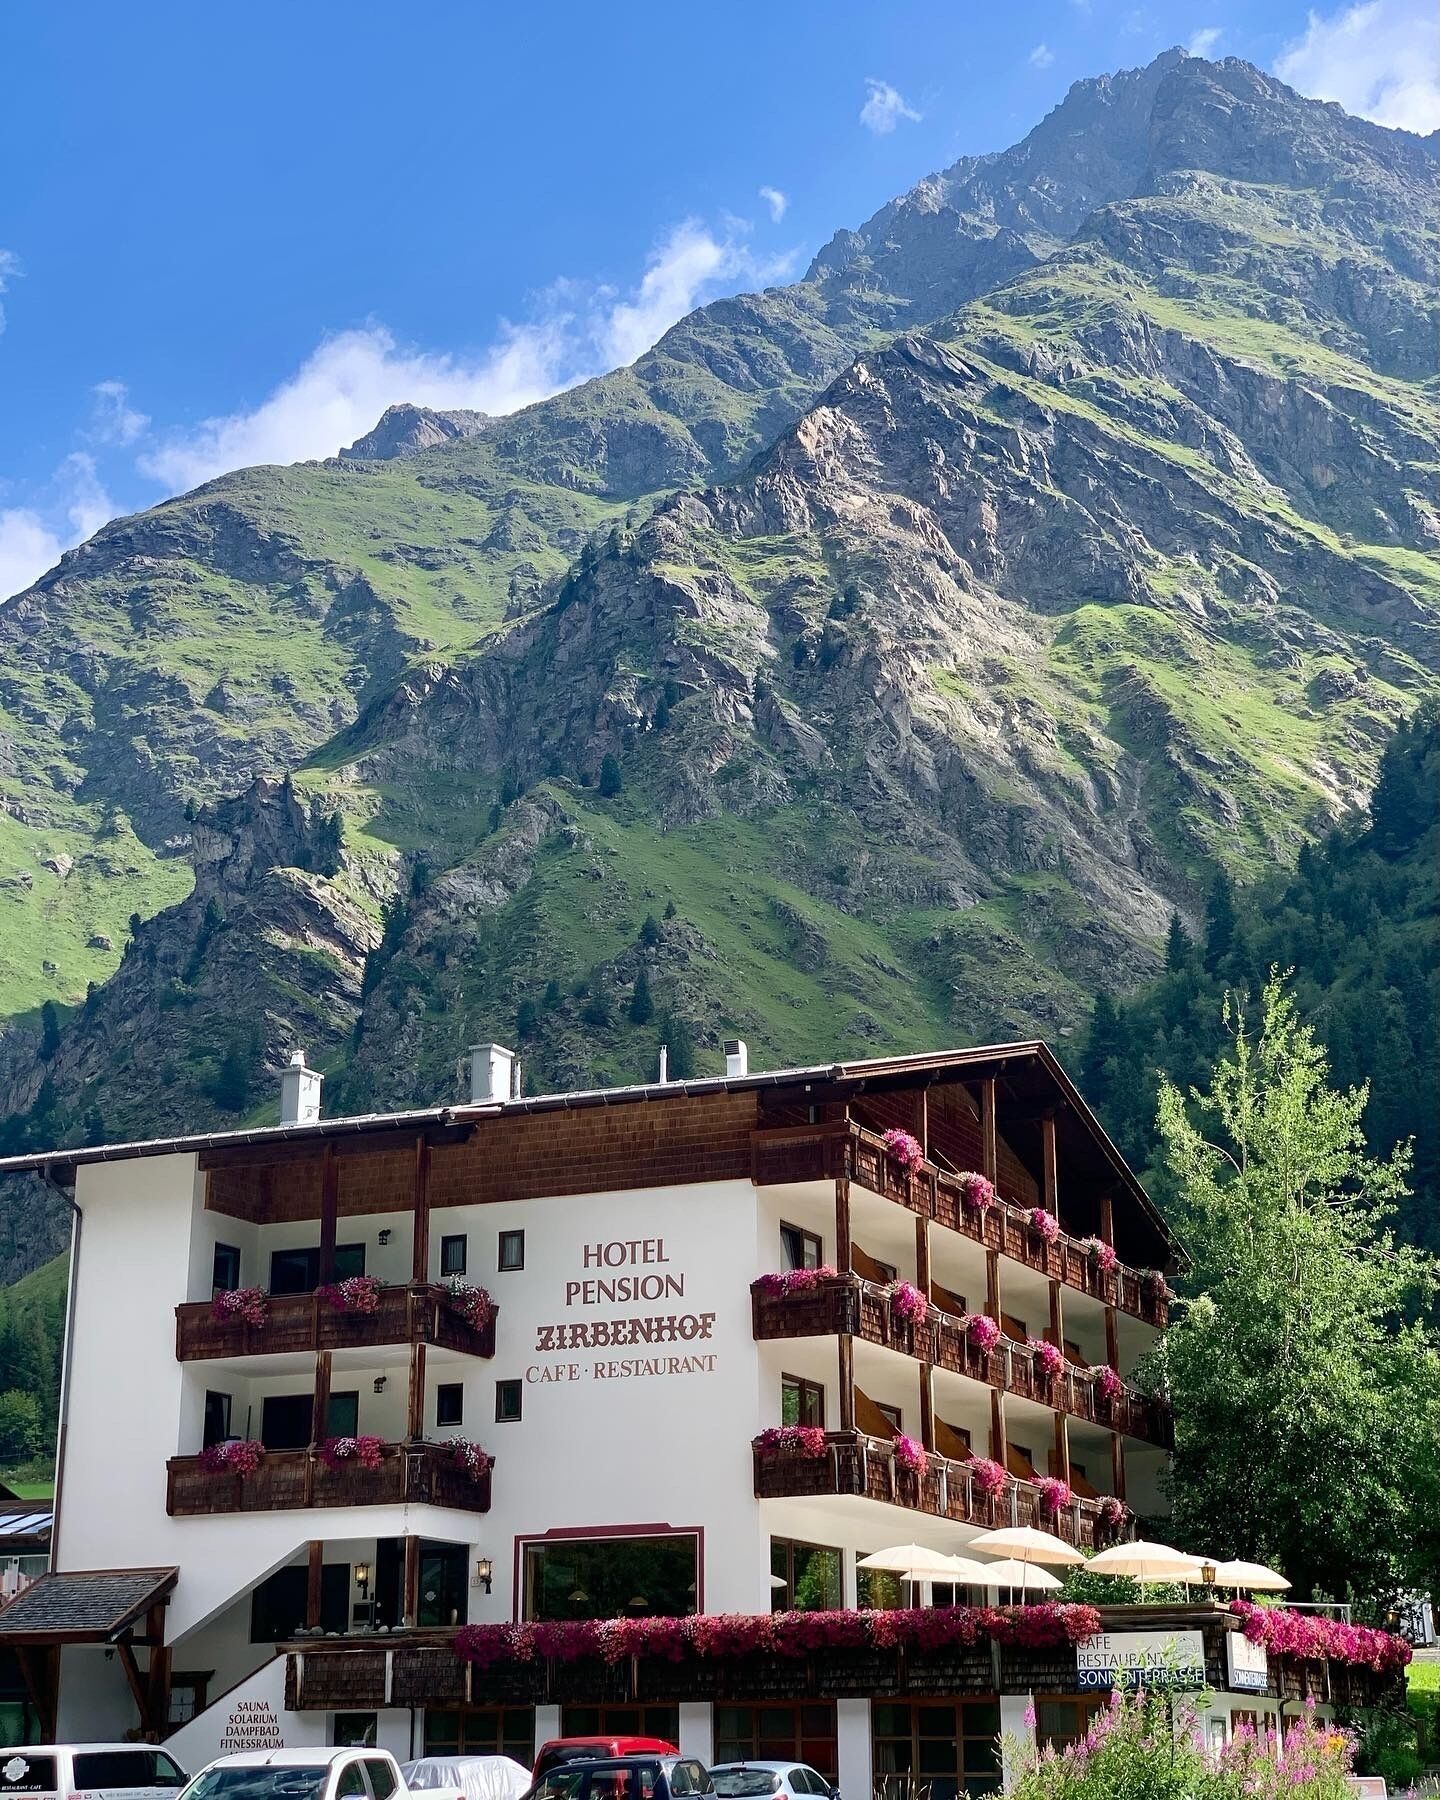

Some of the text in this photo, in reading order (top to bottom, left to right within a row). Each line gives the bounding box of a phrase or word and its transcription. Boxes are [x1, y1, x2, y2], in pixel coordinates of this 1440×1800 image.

[583, 1238, 670, 1268] HOTEL
[566, 1273, 685, 1306] PENSION
[535, 1312, 716, 1351] ZIRBENHOF
[525, 1354, 718, 1383] CAFE RESTAURANT
[1078, 1651, 1166, 1668] RESTAURANT
[237, 1701, 270, 1711] SAUNA
[229, 1714, 278, 1724] SOLARIUM
[226, 1726, 280, 1736] DAMPFBAD
[220, 1738, 284, 1748] FITNESSRAUM
